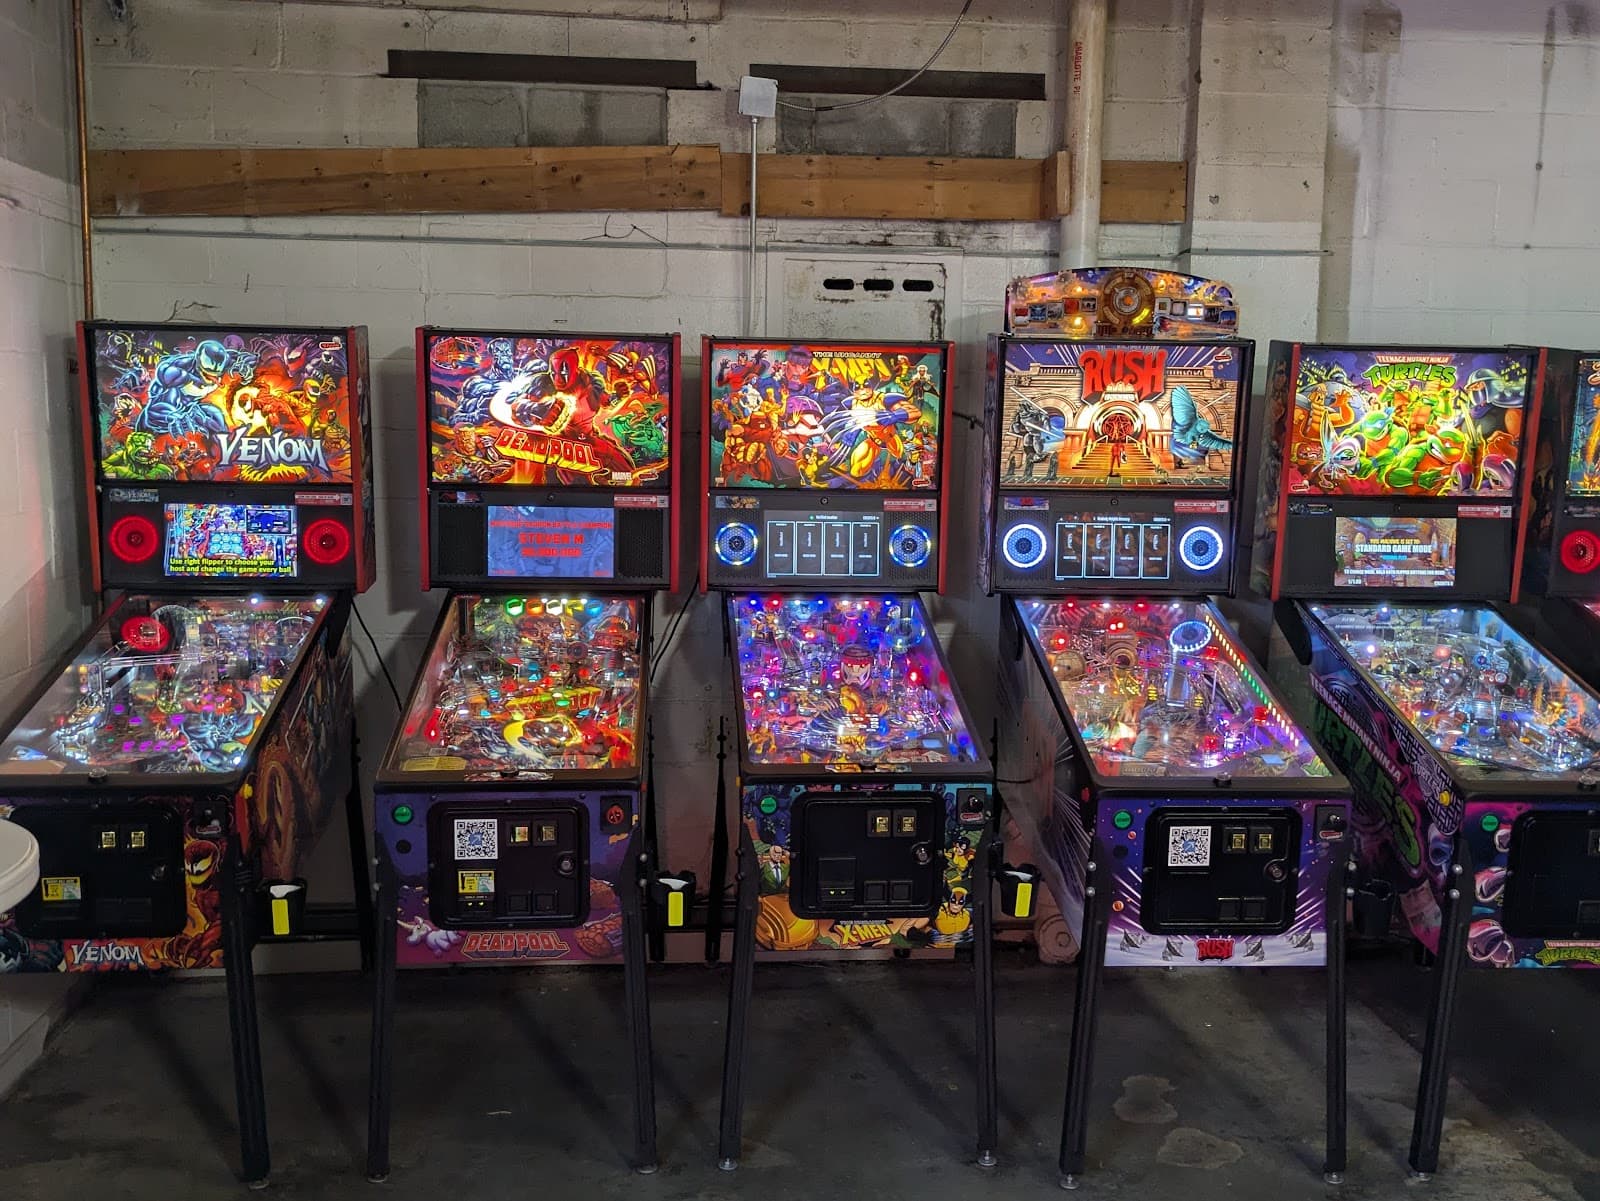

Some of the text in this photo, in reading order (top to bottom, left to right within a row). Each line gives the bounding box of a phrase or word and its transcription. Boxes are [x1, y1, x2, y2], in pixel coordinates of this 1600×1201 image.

[1376, 355, 1449, 363] TEENAGE MUTANT NINJA
[1079, 349, 1168, 402] RUSH
[1362, 362, 1457, 389] TURTLES
[216, 428, 330, 472] VENOM
[495, 427, 602, 473] DEADPOOL
[519, 531, 584, 544] STEVEN M
[1355, 544, 1432, 553] STANDARD GAME MODE
[184, 558, 200, 567] right
[201, 558, 224, 567] flipper
[234, 558, 258, 566] choose
[186, 565, 200, 573] and
[201, 565, 225, 574] change
[238, 567, 257, 575] game
[278, 565, 292, 573] ball
[1310, 672, 1401, 783] TEENAGE MUTANT NINJA
[463, 931, 570, 958] DEADPOOL
[834, 924, 892, 946] X-MEN
[71, 940, 144, 965] VENOM
[1196, 938, 1235, 961] RUSH
